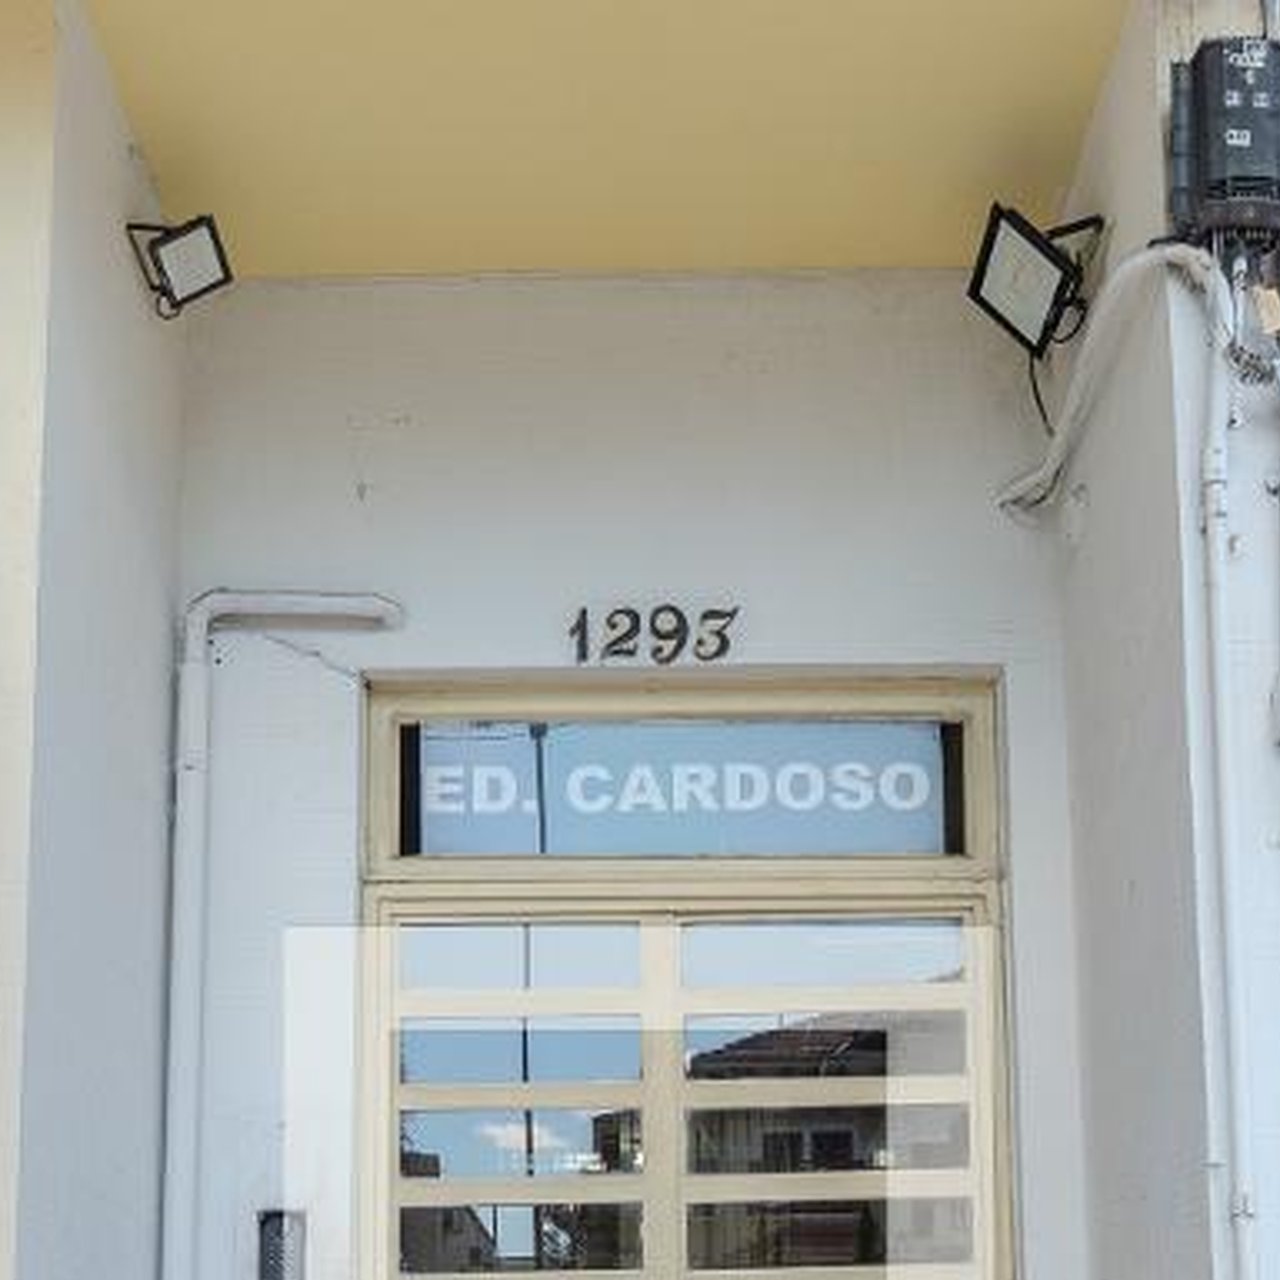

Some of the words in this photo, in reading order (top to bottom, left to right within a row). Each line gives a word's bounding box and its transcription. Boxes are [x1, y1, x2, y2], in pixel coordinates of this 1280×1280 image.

[570, 604, 740, 664] 1293
[425, 764, 537, 812] ED.
[566, 761, 930, 812] CARDOSO
